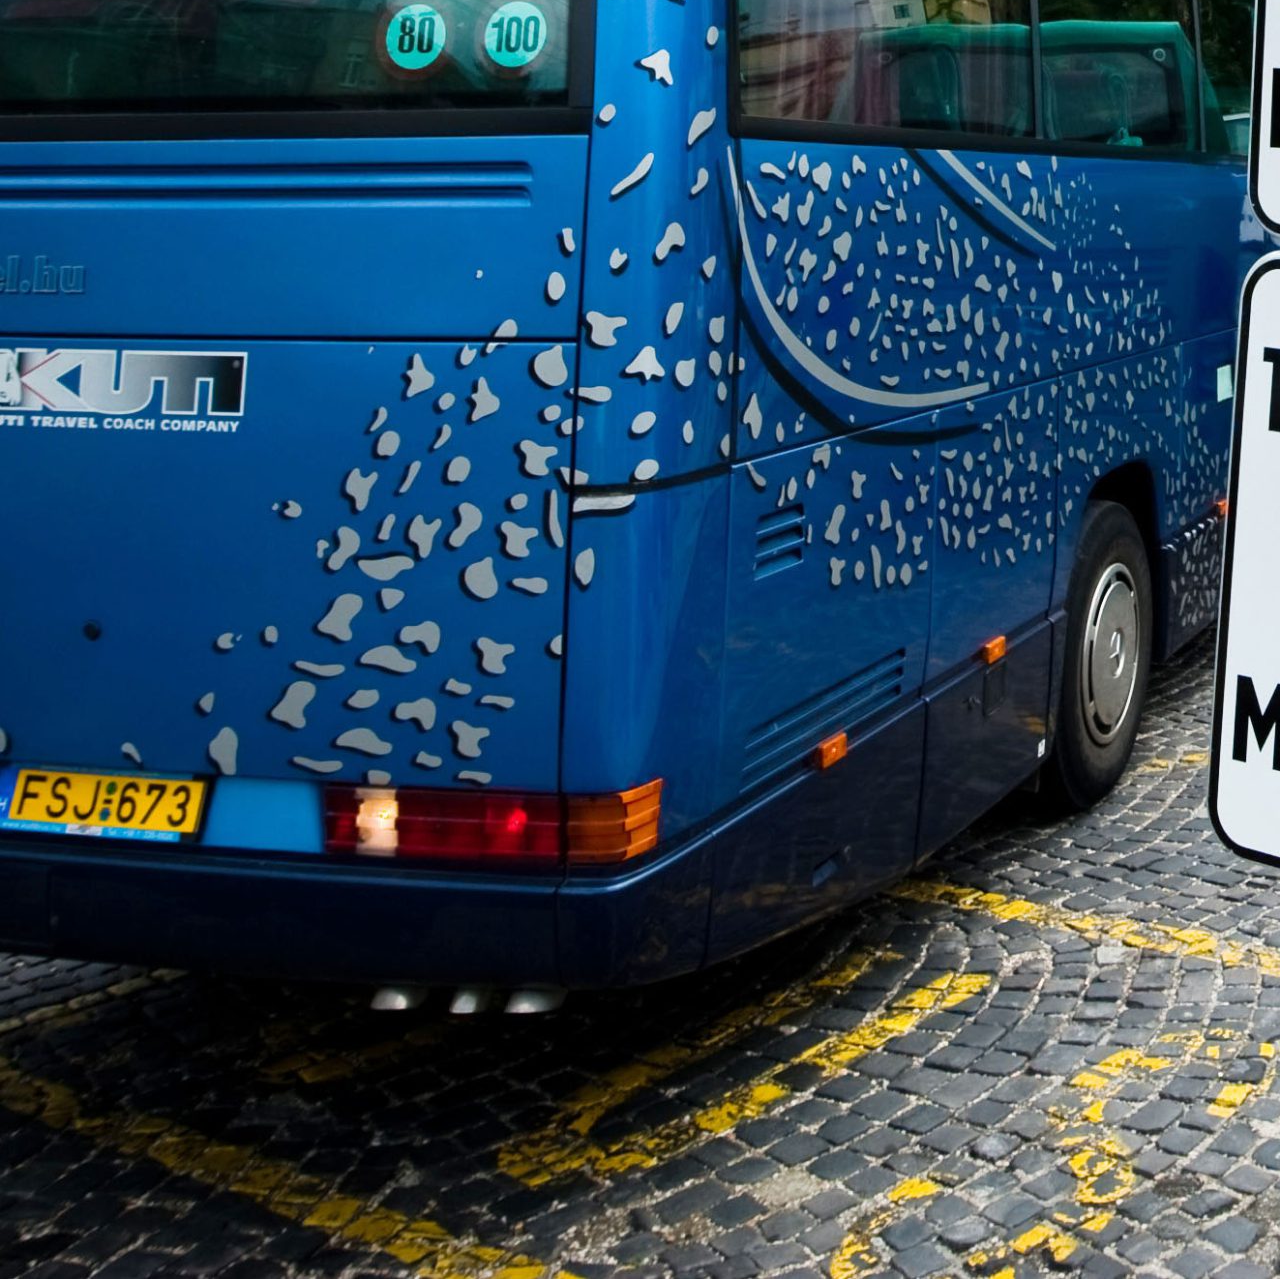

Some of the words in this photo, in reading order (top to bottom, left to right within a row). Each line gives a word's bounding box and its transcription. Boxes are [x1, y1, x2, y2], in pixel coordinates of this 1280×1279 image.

[397, 16, 435, 54] 80
[491, 15, 541, 54] 100
[31, 415, 98, 429] TRAVEL
[103, 418, 155, 430] COACH
[161, 419, 239, 433] COMPANY
